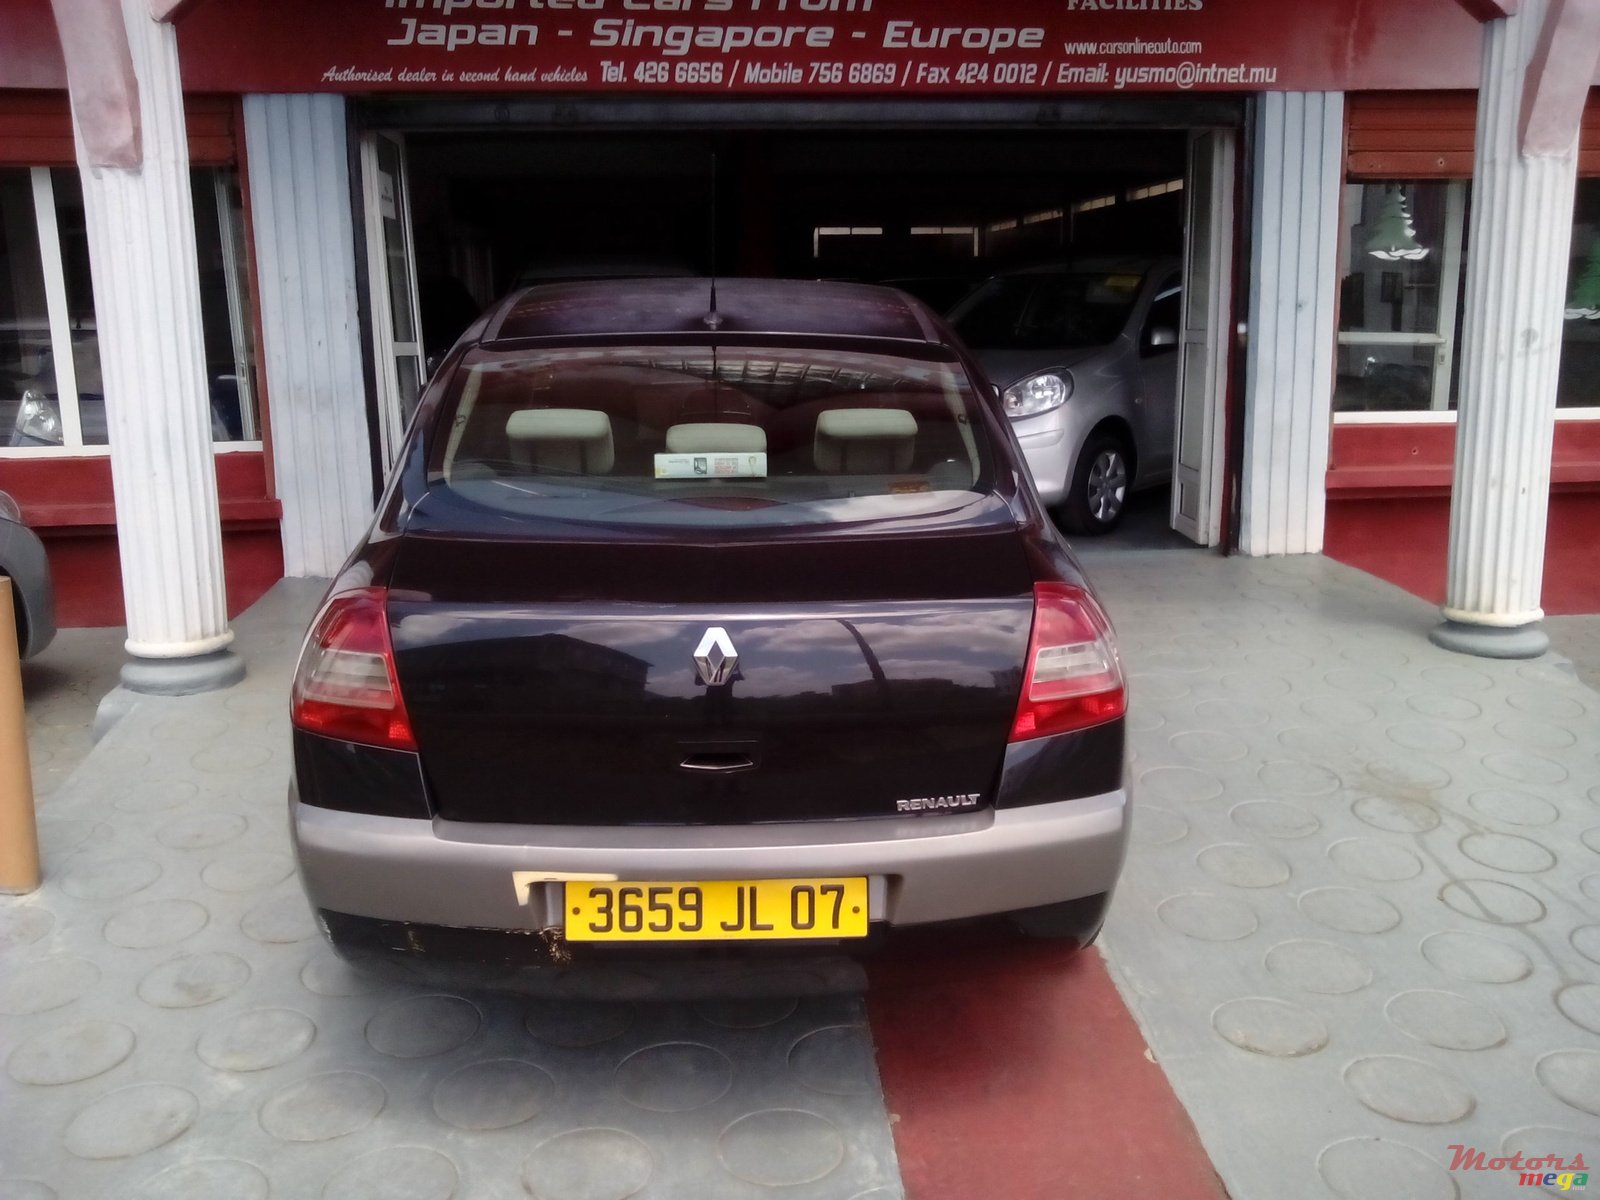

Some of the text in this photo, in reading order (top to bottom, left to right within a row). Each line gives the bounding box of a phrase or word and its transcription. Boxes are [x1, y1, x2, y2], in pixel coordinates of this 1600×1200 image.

[1067, 0, 1204, 11] FACILITIES
[386, 18, 538, 52] Japan
[589, 18, 835, 56] Singapore
[882, 20, 1045, 55] Europe
[1064, 37, 1203, 55] www.carsonlineauto.com
[321, 65, 589, 83] Authorised dealer in second hand vehicles
[600, 60, 628, 83] Tel.
[633, 61, 670, 84] 426
[674, 61, 724, 84] 6656
[743, 61, 804, 84] Mobile
[808, 62, 844, 84] 756
[848, 62, 897, 84] 6869
[915, 63, 950, 84] Fax
[954, 63, 989, 84] 424
[993, 63, 1038, 84] 0012
[1056, 63, 1110, 84] Email:
[1113, 61, 1278, 90] yusmo@intnet.mu
[896, 793, 981, 812] RENAULT
[588, 884, 846, 933] 3659 JL 07
